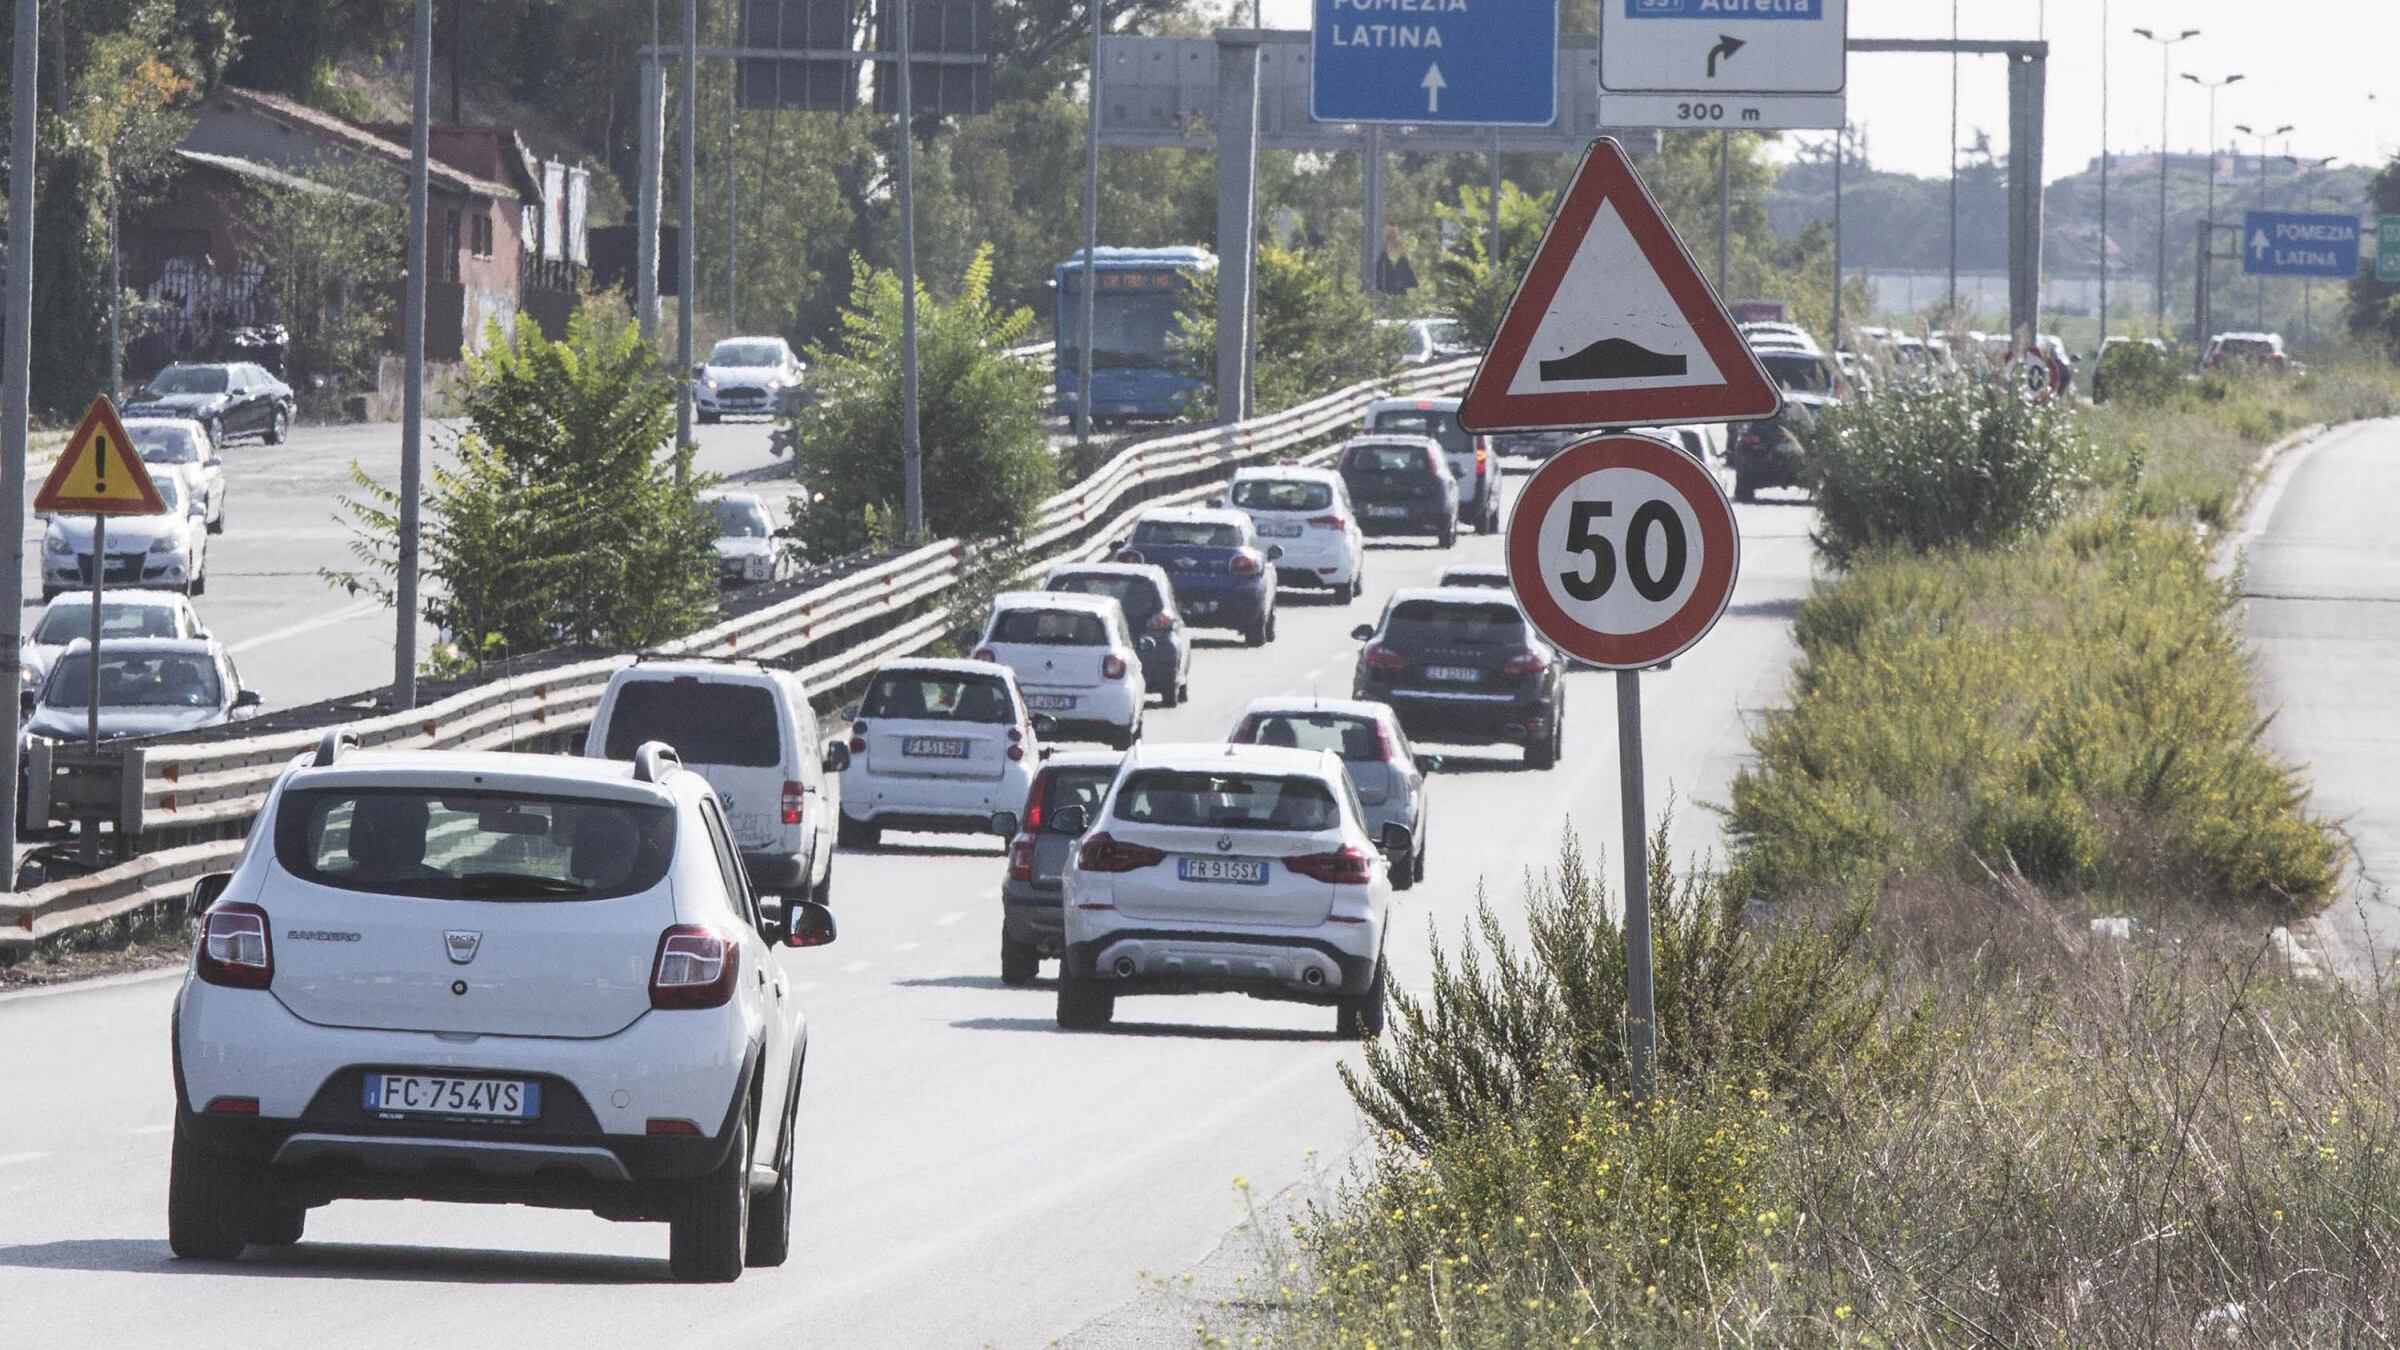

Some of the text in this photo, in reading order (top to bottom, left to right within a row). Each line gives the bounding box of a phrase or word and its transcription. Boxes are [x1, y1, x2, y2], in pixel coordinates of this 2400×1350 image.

[1700, 0, 1809, 12] Aurelia
[1332, 24, 1443, 48] LATINA
[1677, 103, 1760, 121] 300 m
[2276, 223, 2355, 241] POMEZIA
[2275, 250, 2337, 268] LATINA
[1560, 499, 1687, 602] 50
[288, 930, 362, 942] SANDERO
[449, 934, 475, 943] DACIA
